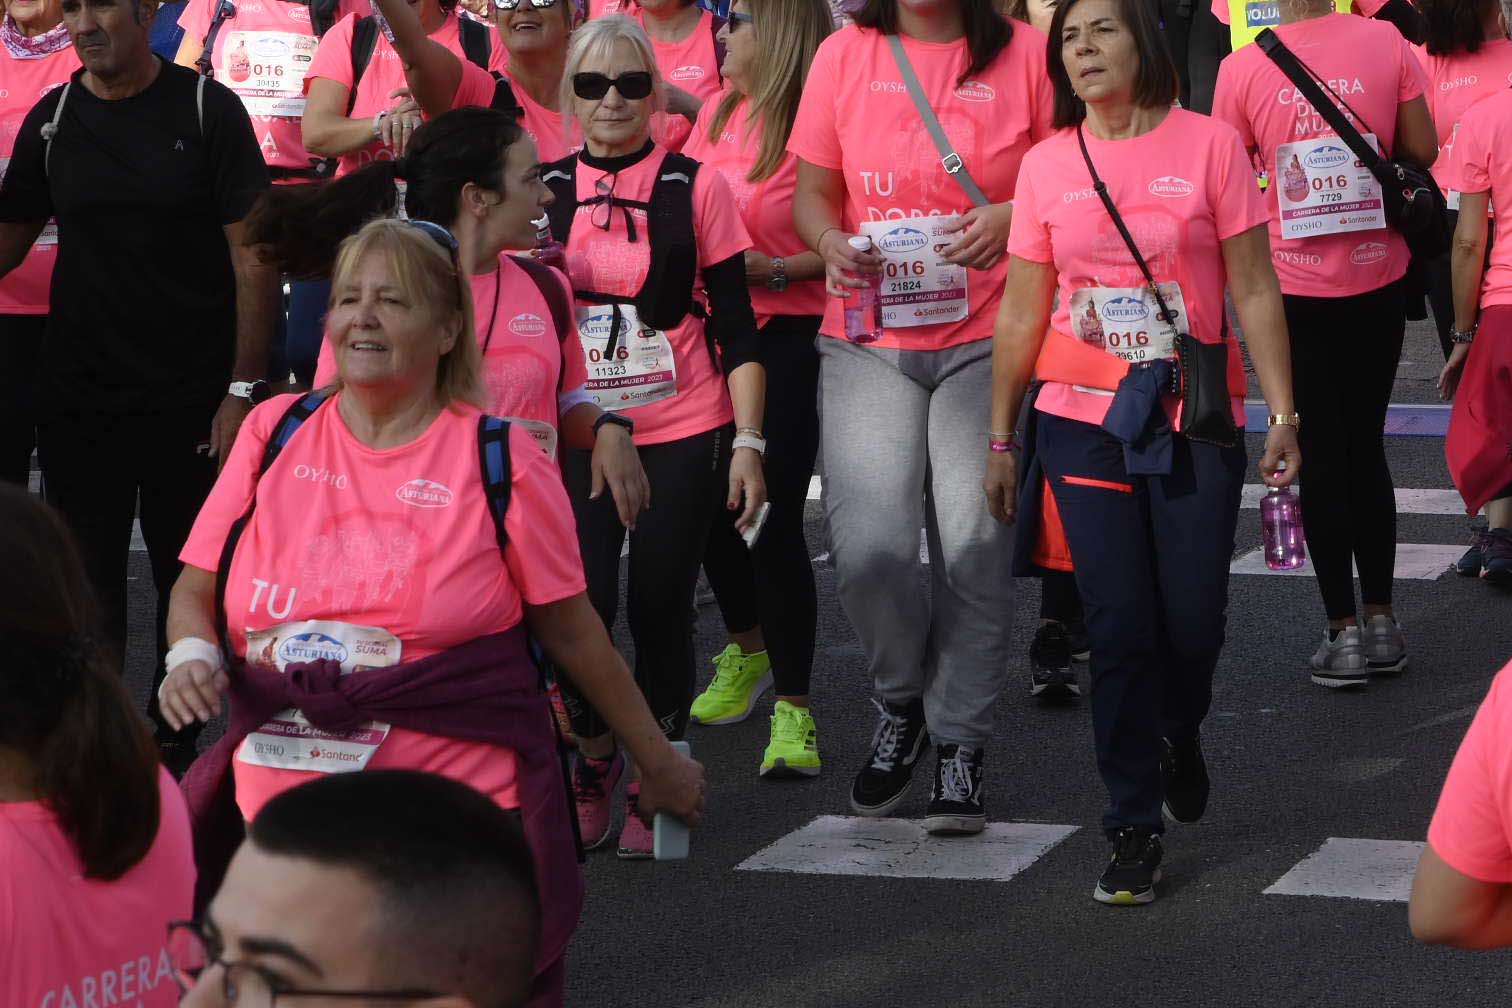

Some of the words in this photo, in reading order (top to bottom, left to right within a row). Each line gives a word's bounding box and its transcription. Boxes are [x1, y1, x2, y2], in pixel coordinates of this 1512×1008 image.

[253, 63, 284, 77] 016
[869, 80, 907, 94] OYSH
[1439, 74, 1478, 92] OYSHO
[1307, 153, 1348, 165] ASTURIANA
[859, 170, 894, 197] TU
[1152, 182, 1192, 194] ASTURIANA
[1311, 174, 1348, 192] 016
[1319, 192, 1343, 203] 7729
[1292, 207, 1321, 218] CARRERA
[1321, 206, 1330, 214] DE
[1330, 205, 1340, 213] LA
[1340, 203, 1360, 212] MUJER
[1291, 220, 1323, 233] OYSHO
[881, 236, 926, 250] ASTURIANA
[1273, 249, 1322, 267] OYSHO
[885, 260, 926, 279] 016
[890, 280, 922, 292] 21824
[923, 305, 960, 317] Santander
[1105, 304, 1148, 317] ASTURIANA
[581, 322, 628, 335] ASTURNA
[1108, 330, 1149, 347] 016
[588, 346, 630, 363] 06
[594, 365, 627, 377] 11323
[620, 377, 645, 386] MUJER
[399, 486, 450, 504] ASTURIANA
[247, 577, 297, 620] TU
[281, 642, 347, 660] ASTURIANA
[355, 645, 388, 657] SUMA
[253, 742, 285, 757] OYSHO
[39, 946, 176, 1008] CARRERA
